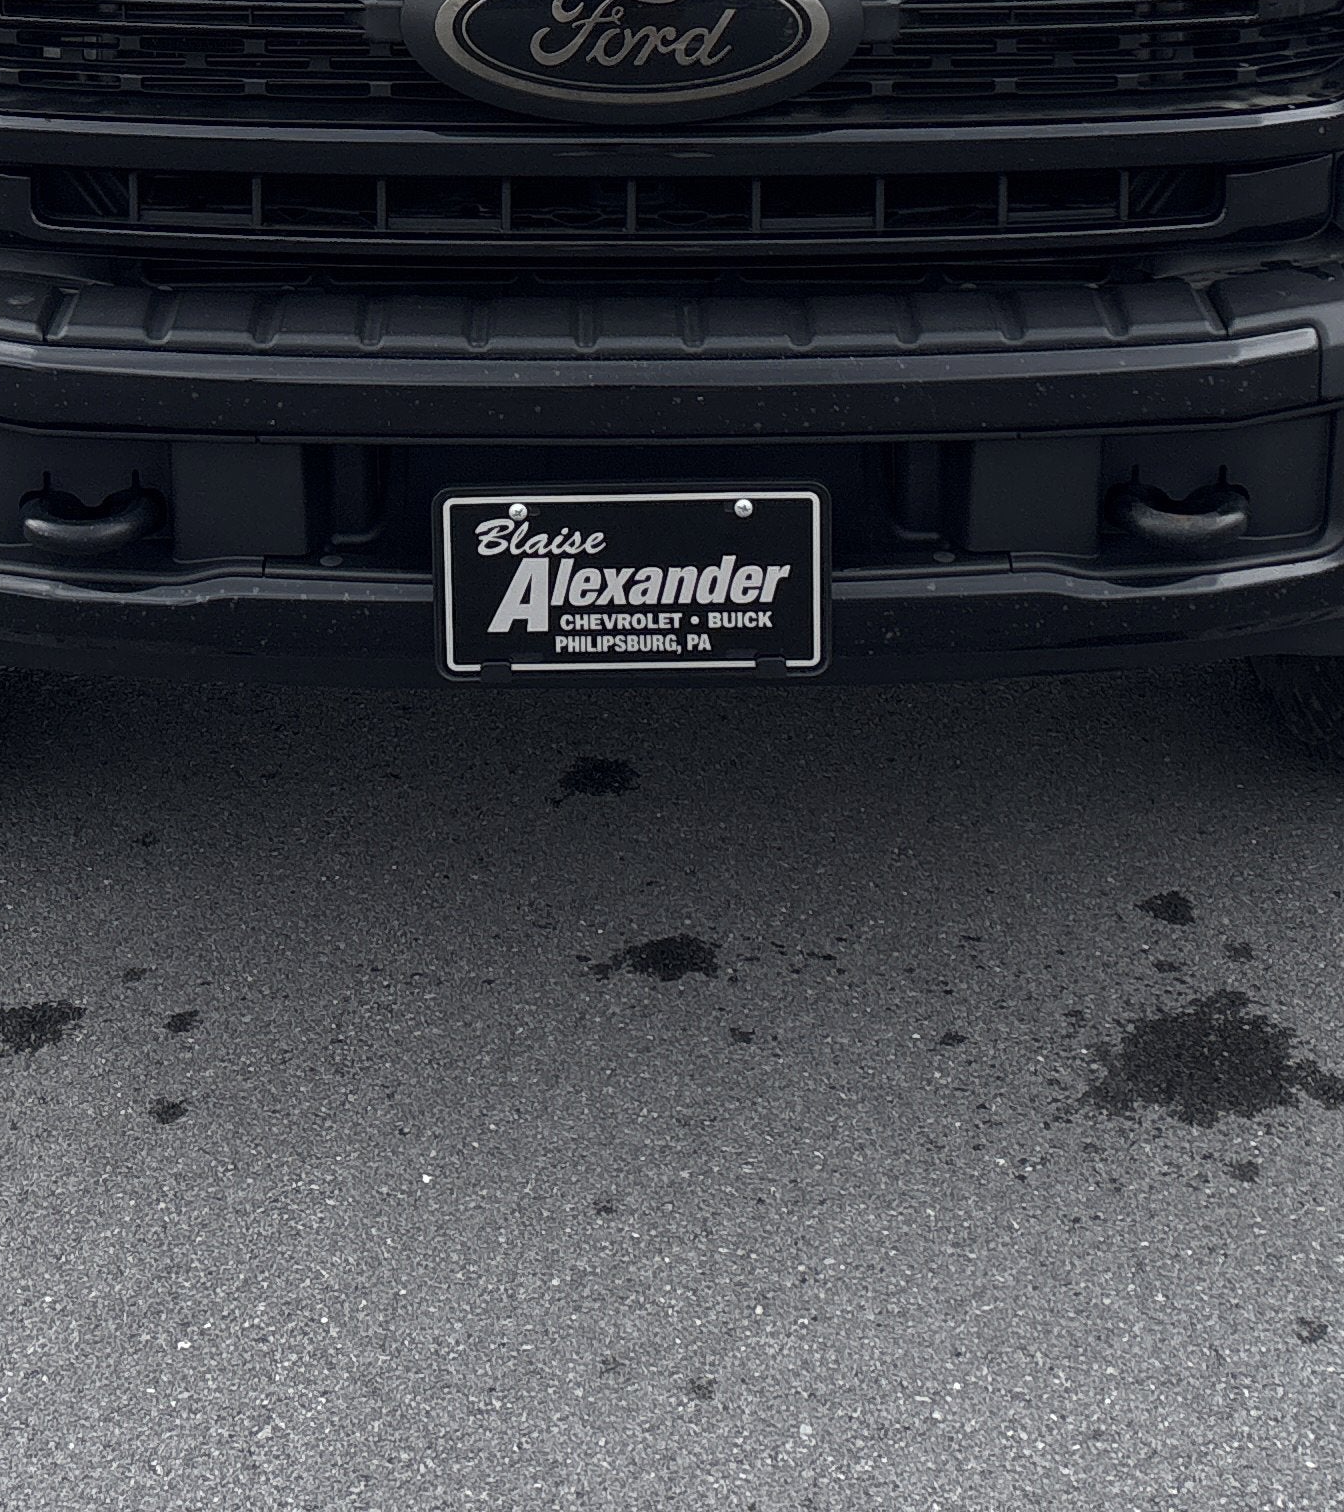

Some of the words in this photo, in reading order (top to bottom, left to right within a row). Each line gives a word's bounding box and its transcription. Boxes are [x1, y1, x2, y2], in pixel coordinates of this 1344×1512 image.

[474, 518, 607, 556] Blaise
[487, 554, 791, 633] Alexander
[559, 612, 683, 631] CHEVROLET
[707, 611, 774, 628] BUICK
[555, 634, 682, 654] PHILIPSBURG,
[687, 634, 712, 651] PA
